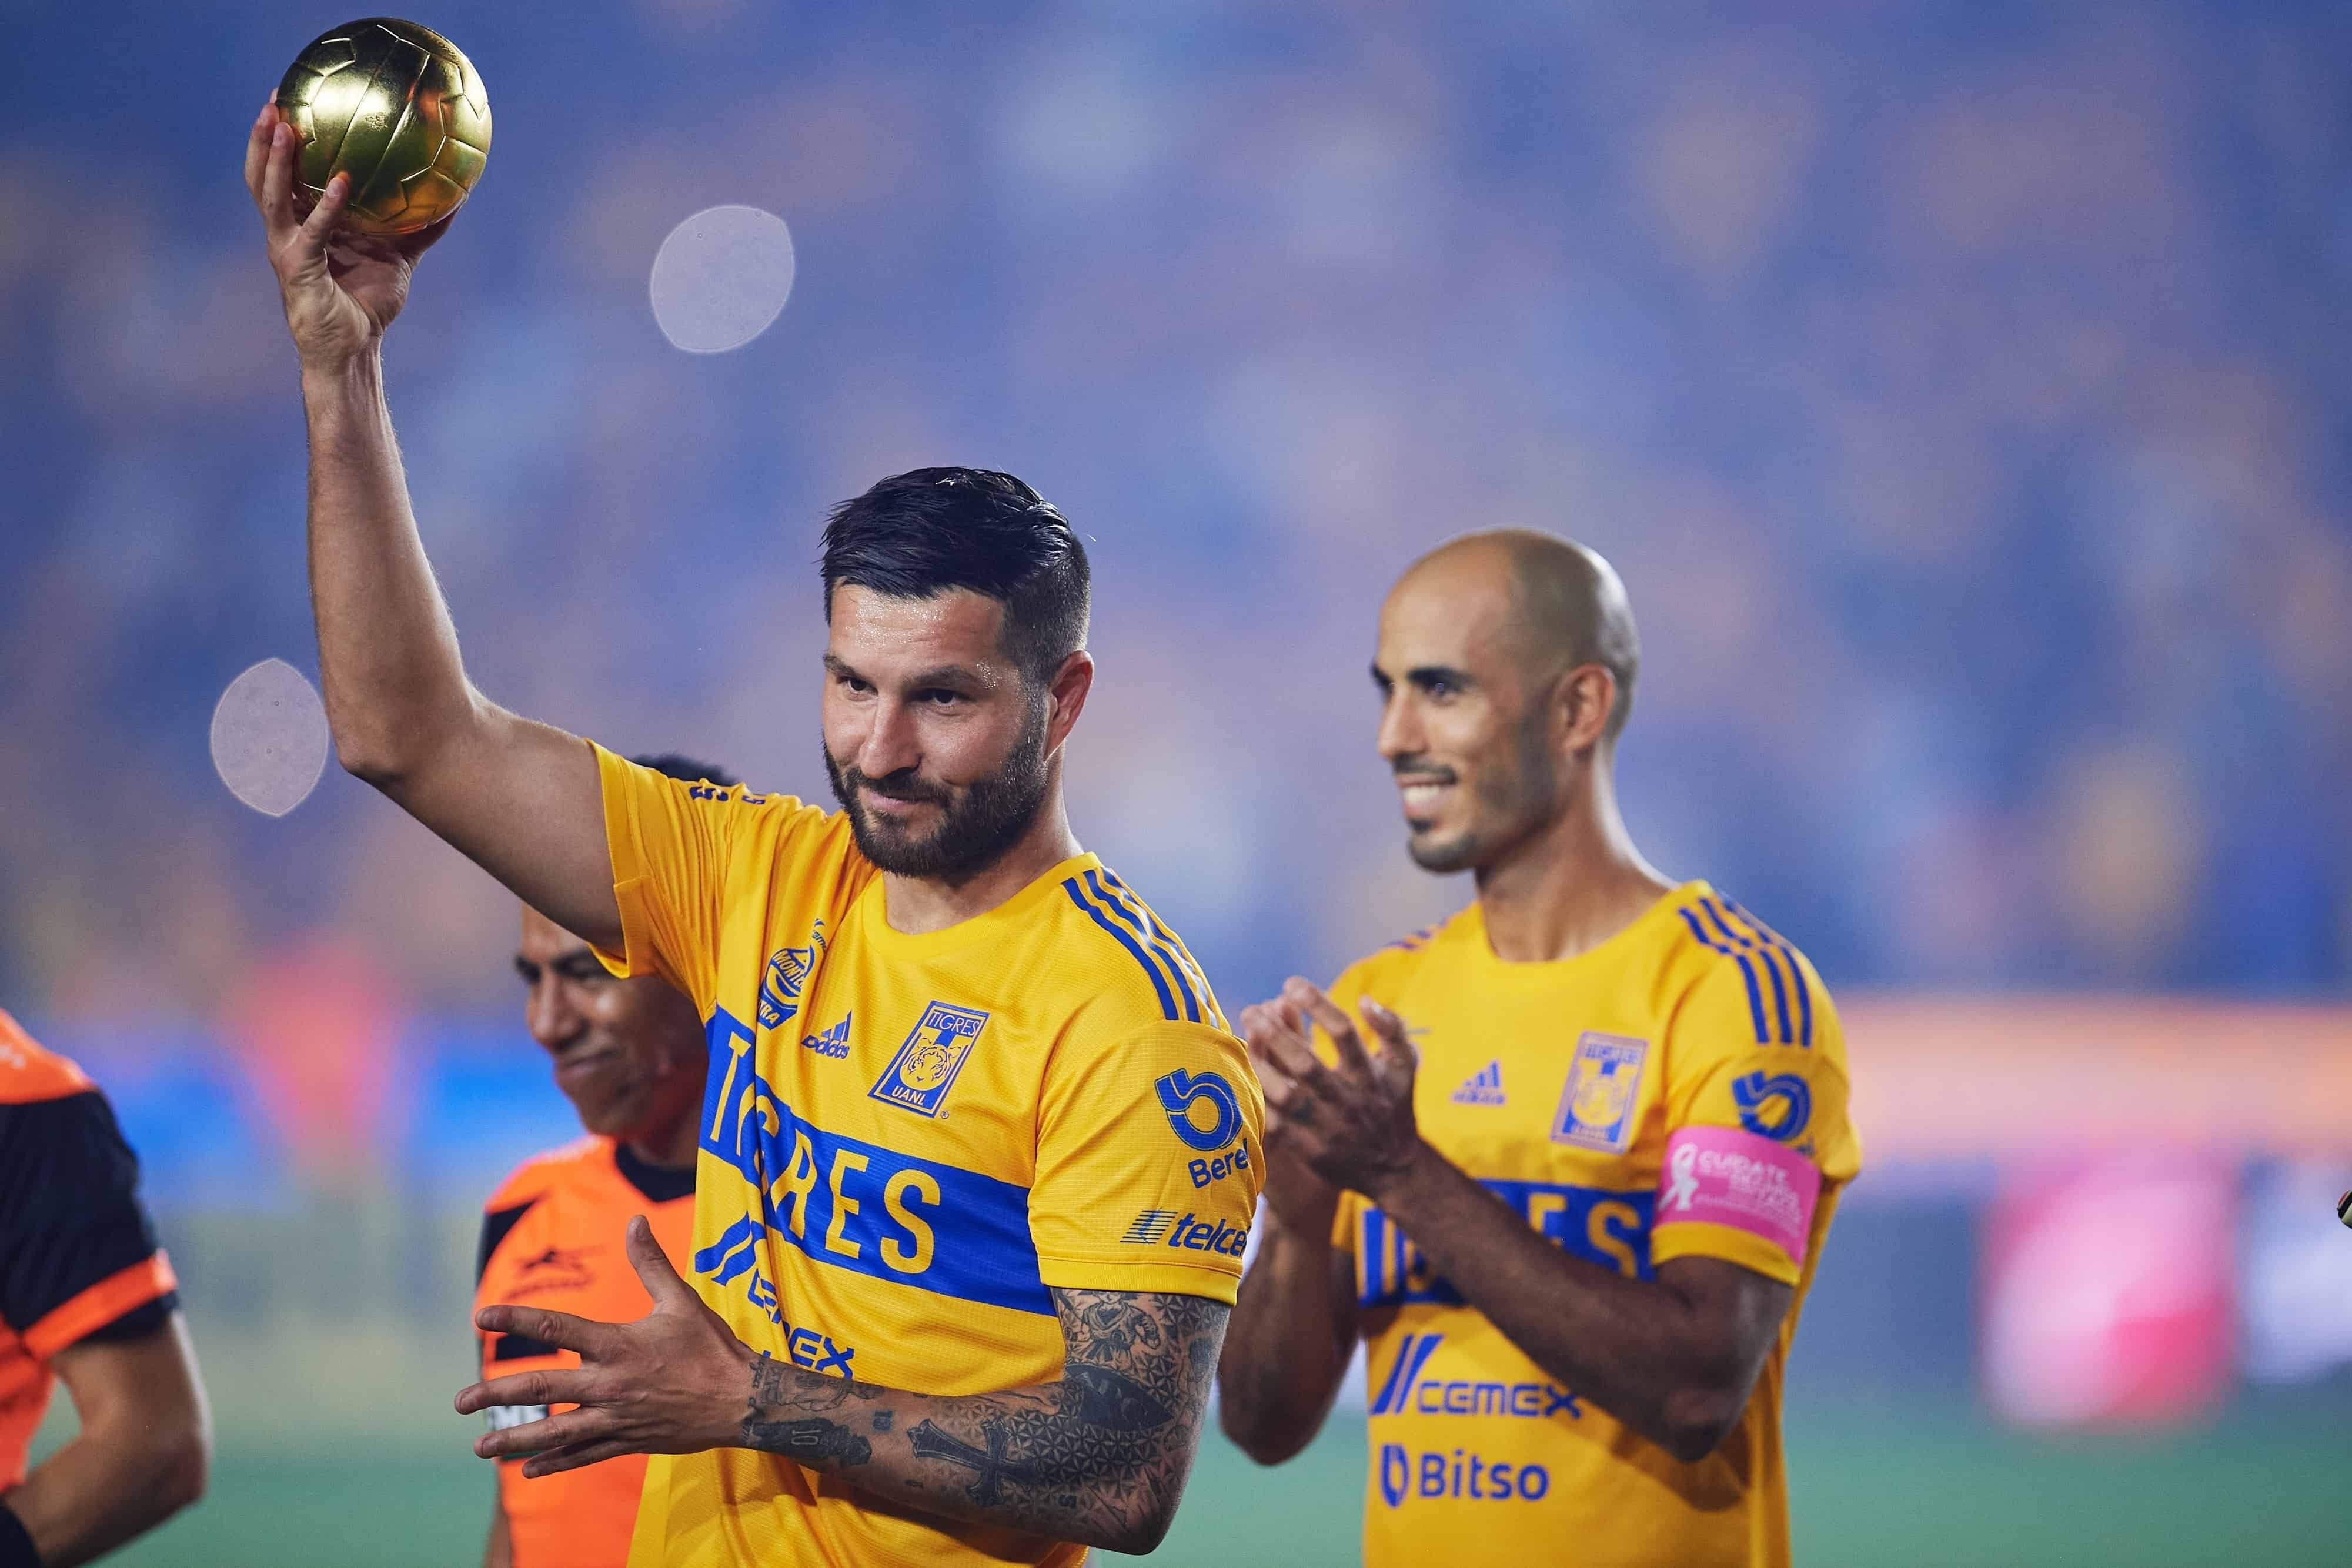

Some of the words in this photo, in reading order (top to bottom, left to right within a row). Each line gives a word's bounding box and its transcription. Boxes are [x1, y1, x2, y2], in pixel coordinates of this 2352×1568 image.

[928, 1011, 980, 1037] TIGRES
[891, 1085, 926, 1105] UANL
[1417, 1381, 1582, 1420] CEMEX
[1418, 1449, 1551, 1500] Bitso
